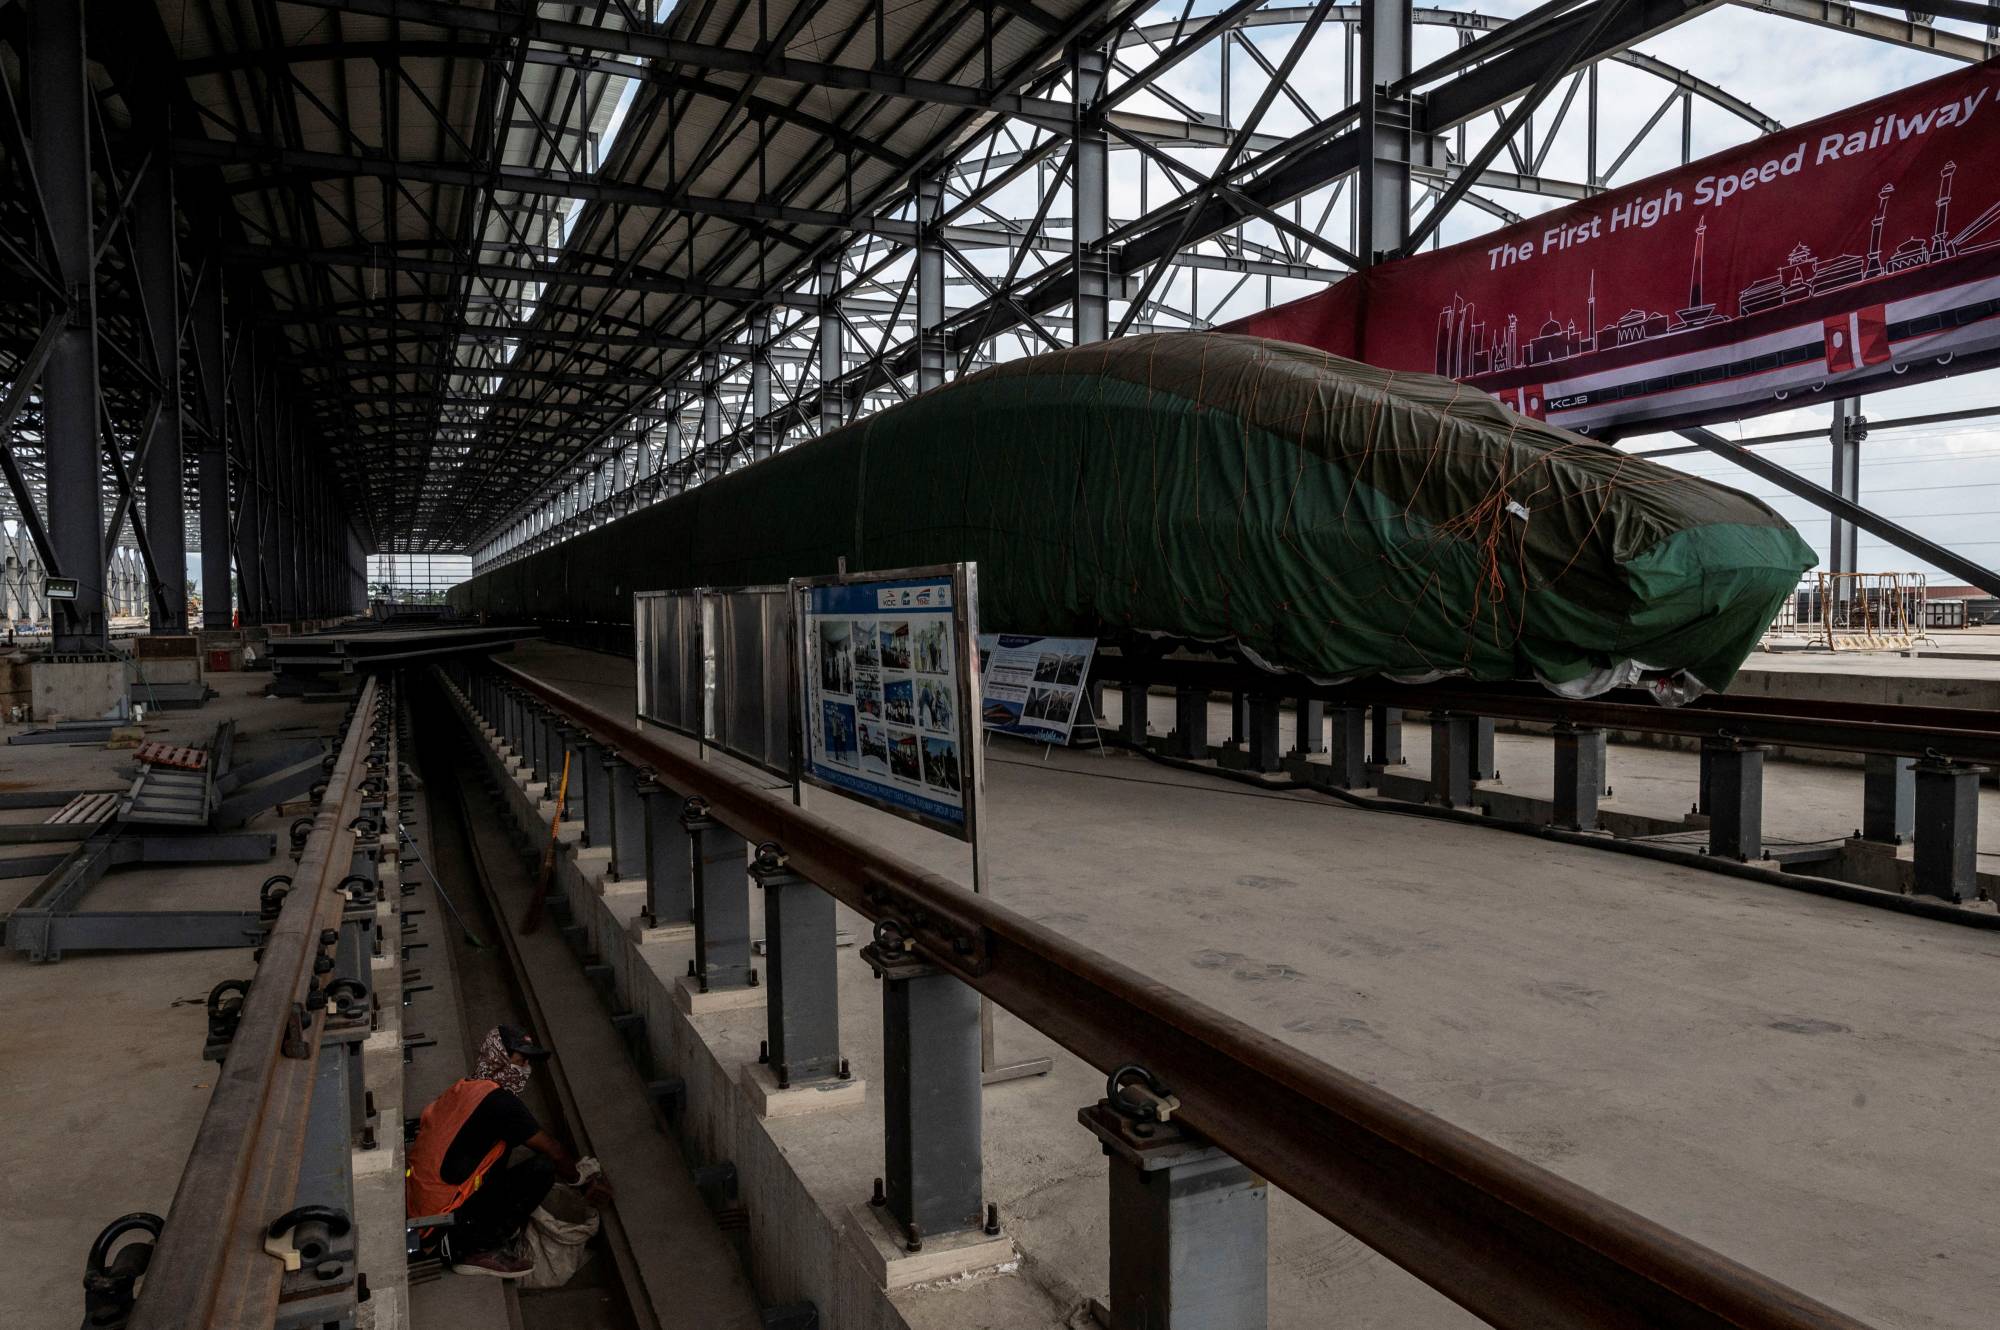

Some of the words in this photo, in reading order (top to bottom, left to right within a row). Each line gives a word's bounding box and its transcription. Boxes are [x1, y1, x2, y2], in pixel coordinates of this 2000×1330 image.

[1487, 241, 1534, 271] The
[1542, 214, 1602, 255] First
[1610, 188, 1683, 232] High
[1693, 142, 1807, 207] Speed
[1815, 87, 1989, 166] Railway
[1550, 395, 1588, 409] KCJB
